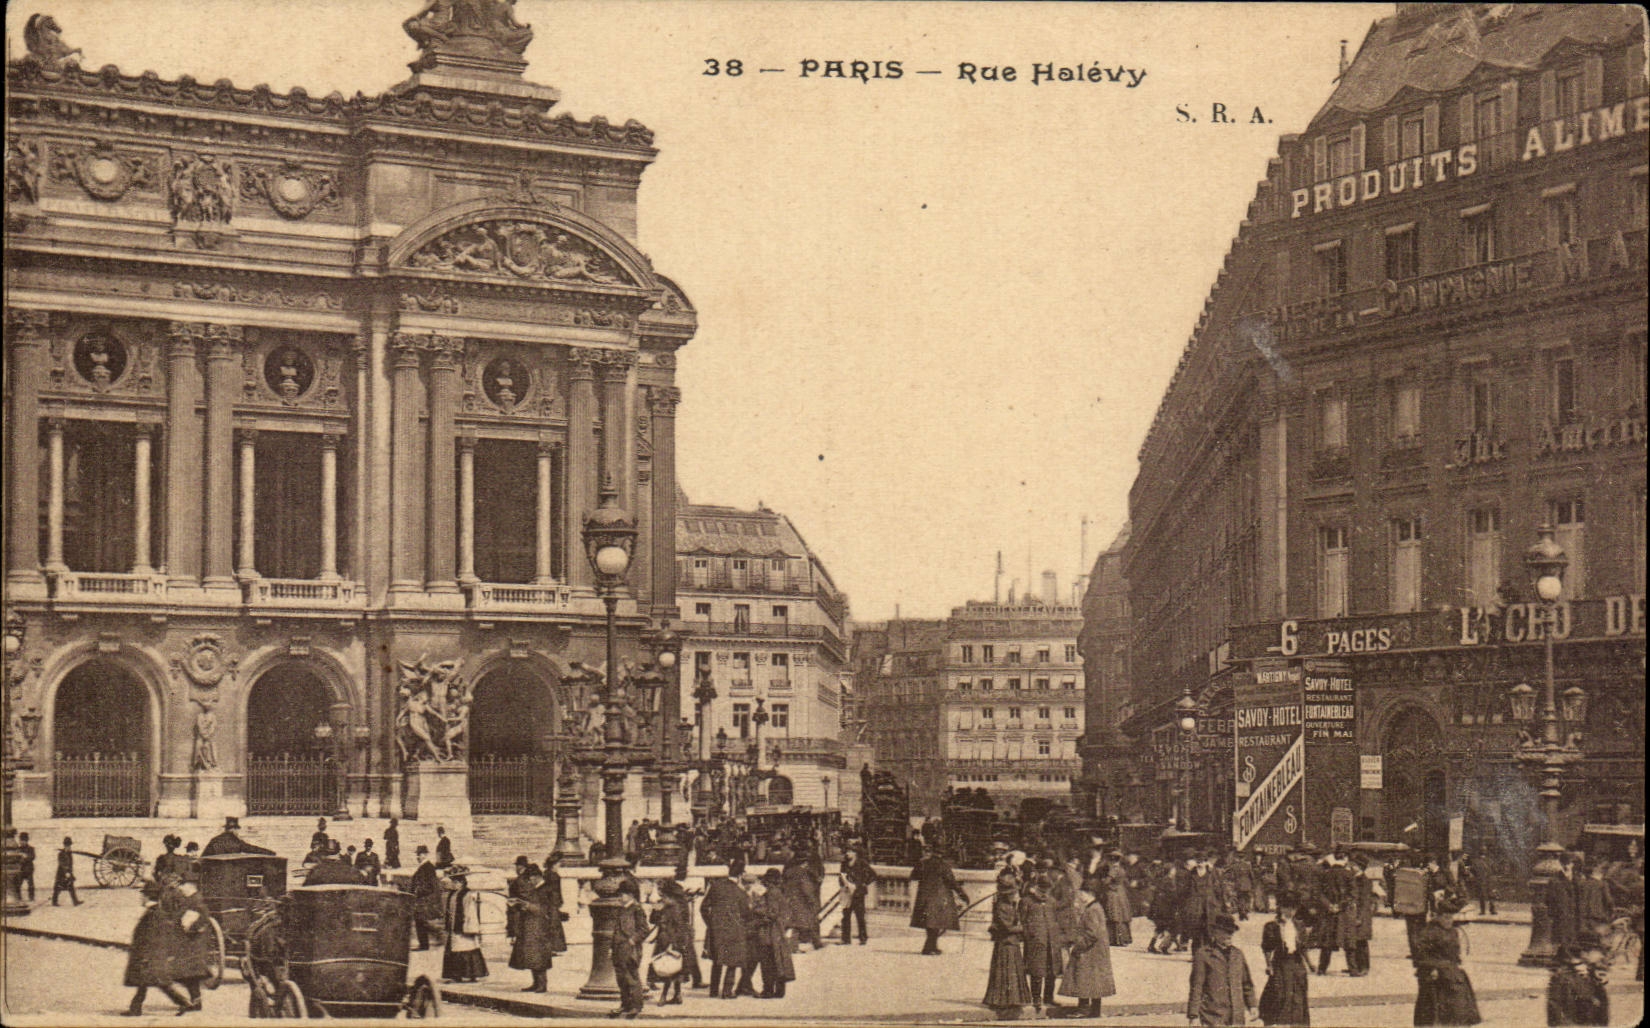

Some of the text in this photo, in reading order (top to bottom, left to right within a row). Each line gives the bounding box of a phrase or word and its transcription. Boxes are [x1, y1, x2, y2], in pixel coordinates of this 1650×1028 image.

[1291, 144, 1479, 219] PRODUITS
[1281, 620, 1299, 656] 6
[1327, 627, 1391, 655] PAGES
[1238, 733, 1292, 748] RESTAURANT
[1239, 744, 1302, 844] FONTAINEBLEAU
